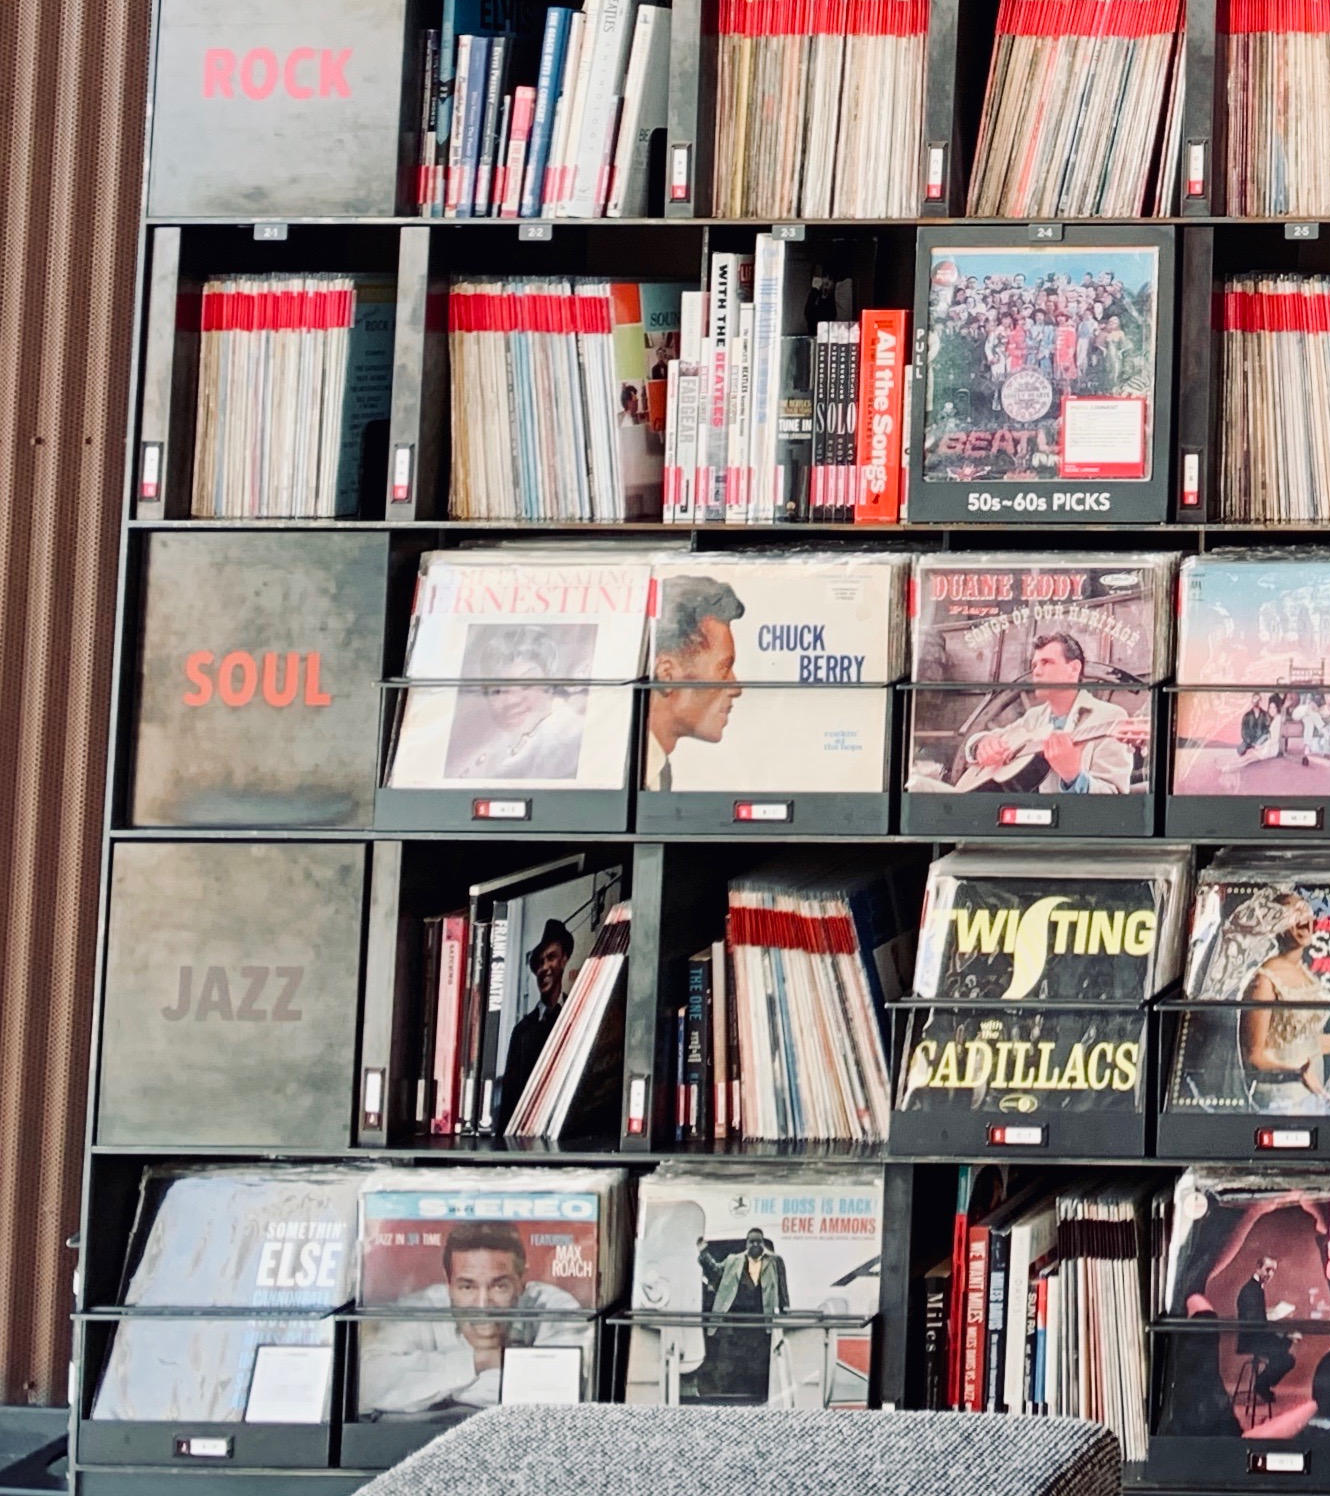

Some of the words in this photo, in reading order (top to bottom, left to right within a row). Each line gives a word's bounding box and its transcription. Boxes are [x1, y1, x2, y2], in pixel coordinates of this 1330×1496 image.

[202, 48, 354, 100] ROCK
[717, 265, 728, 310] WITH
[716, 314, 726, 347] THE
[916, 329, 926, 379] PULL
[710, 352, 725, 427] BEATLES
[778, 418, 799, 432] TUNE
[801, 418, 812, 431] IN
[968, 493, 1047, 512] 50s~60s
[1053, 493, 1111, 511] PICKS
[427, 584, 645, 614] ERNESTINE
[929, 573, 1013, 601] DUANE
[1021, 573, 1087, 601] EDDY
[948, 604, 1000, 615] Plays
[758, 625, 827, 652] CHUCK
[964, 619, 1009, 649] SONGS
[1012, 610, 1031, 625] OF
[1034, 605, 1064, 620] OUR
[1067, 605, 1141, 648] HERITAGE
[183, 650, 332, 708] SOUL
[799, 655, 865, 684] BERRY
[494, 918, 509, 958] FRANK
[161, 965, 305, 1023] JAZZ
[488, 960, 507, 1012] SINATRA
[910, 1040, 1139, 1091] CADILLACS
[417, 1198, 593, 1219] STEREO
[753, 1198, 777, 1214] THE
[782, 1197, 816, 1214] BOSS
[820, 1197, 833, 1214] IS
[781, 1216, 815, 1234] GENE
[819, 1217, 876, 1235] AMMONS
[254, 1242, 343, 1288] ELSE
[555, 1245, 582, 1262] MAX
[552, 1260, 592, 1278] ROACH
[1027, 1292, 1037, 1318] SUN
[925, 1293, 944, 1352] Miles
[1026, 1319, 1035, 1335] RA
